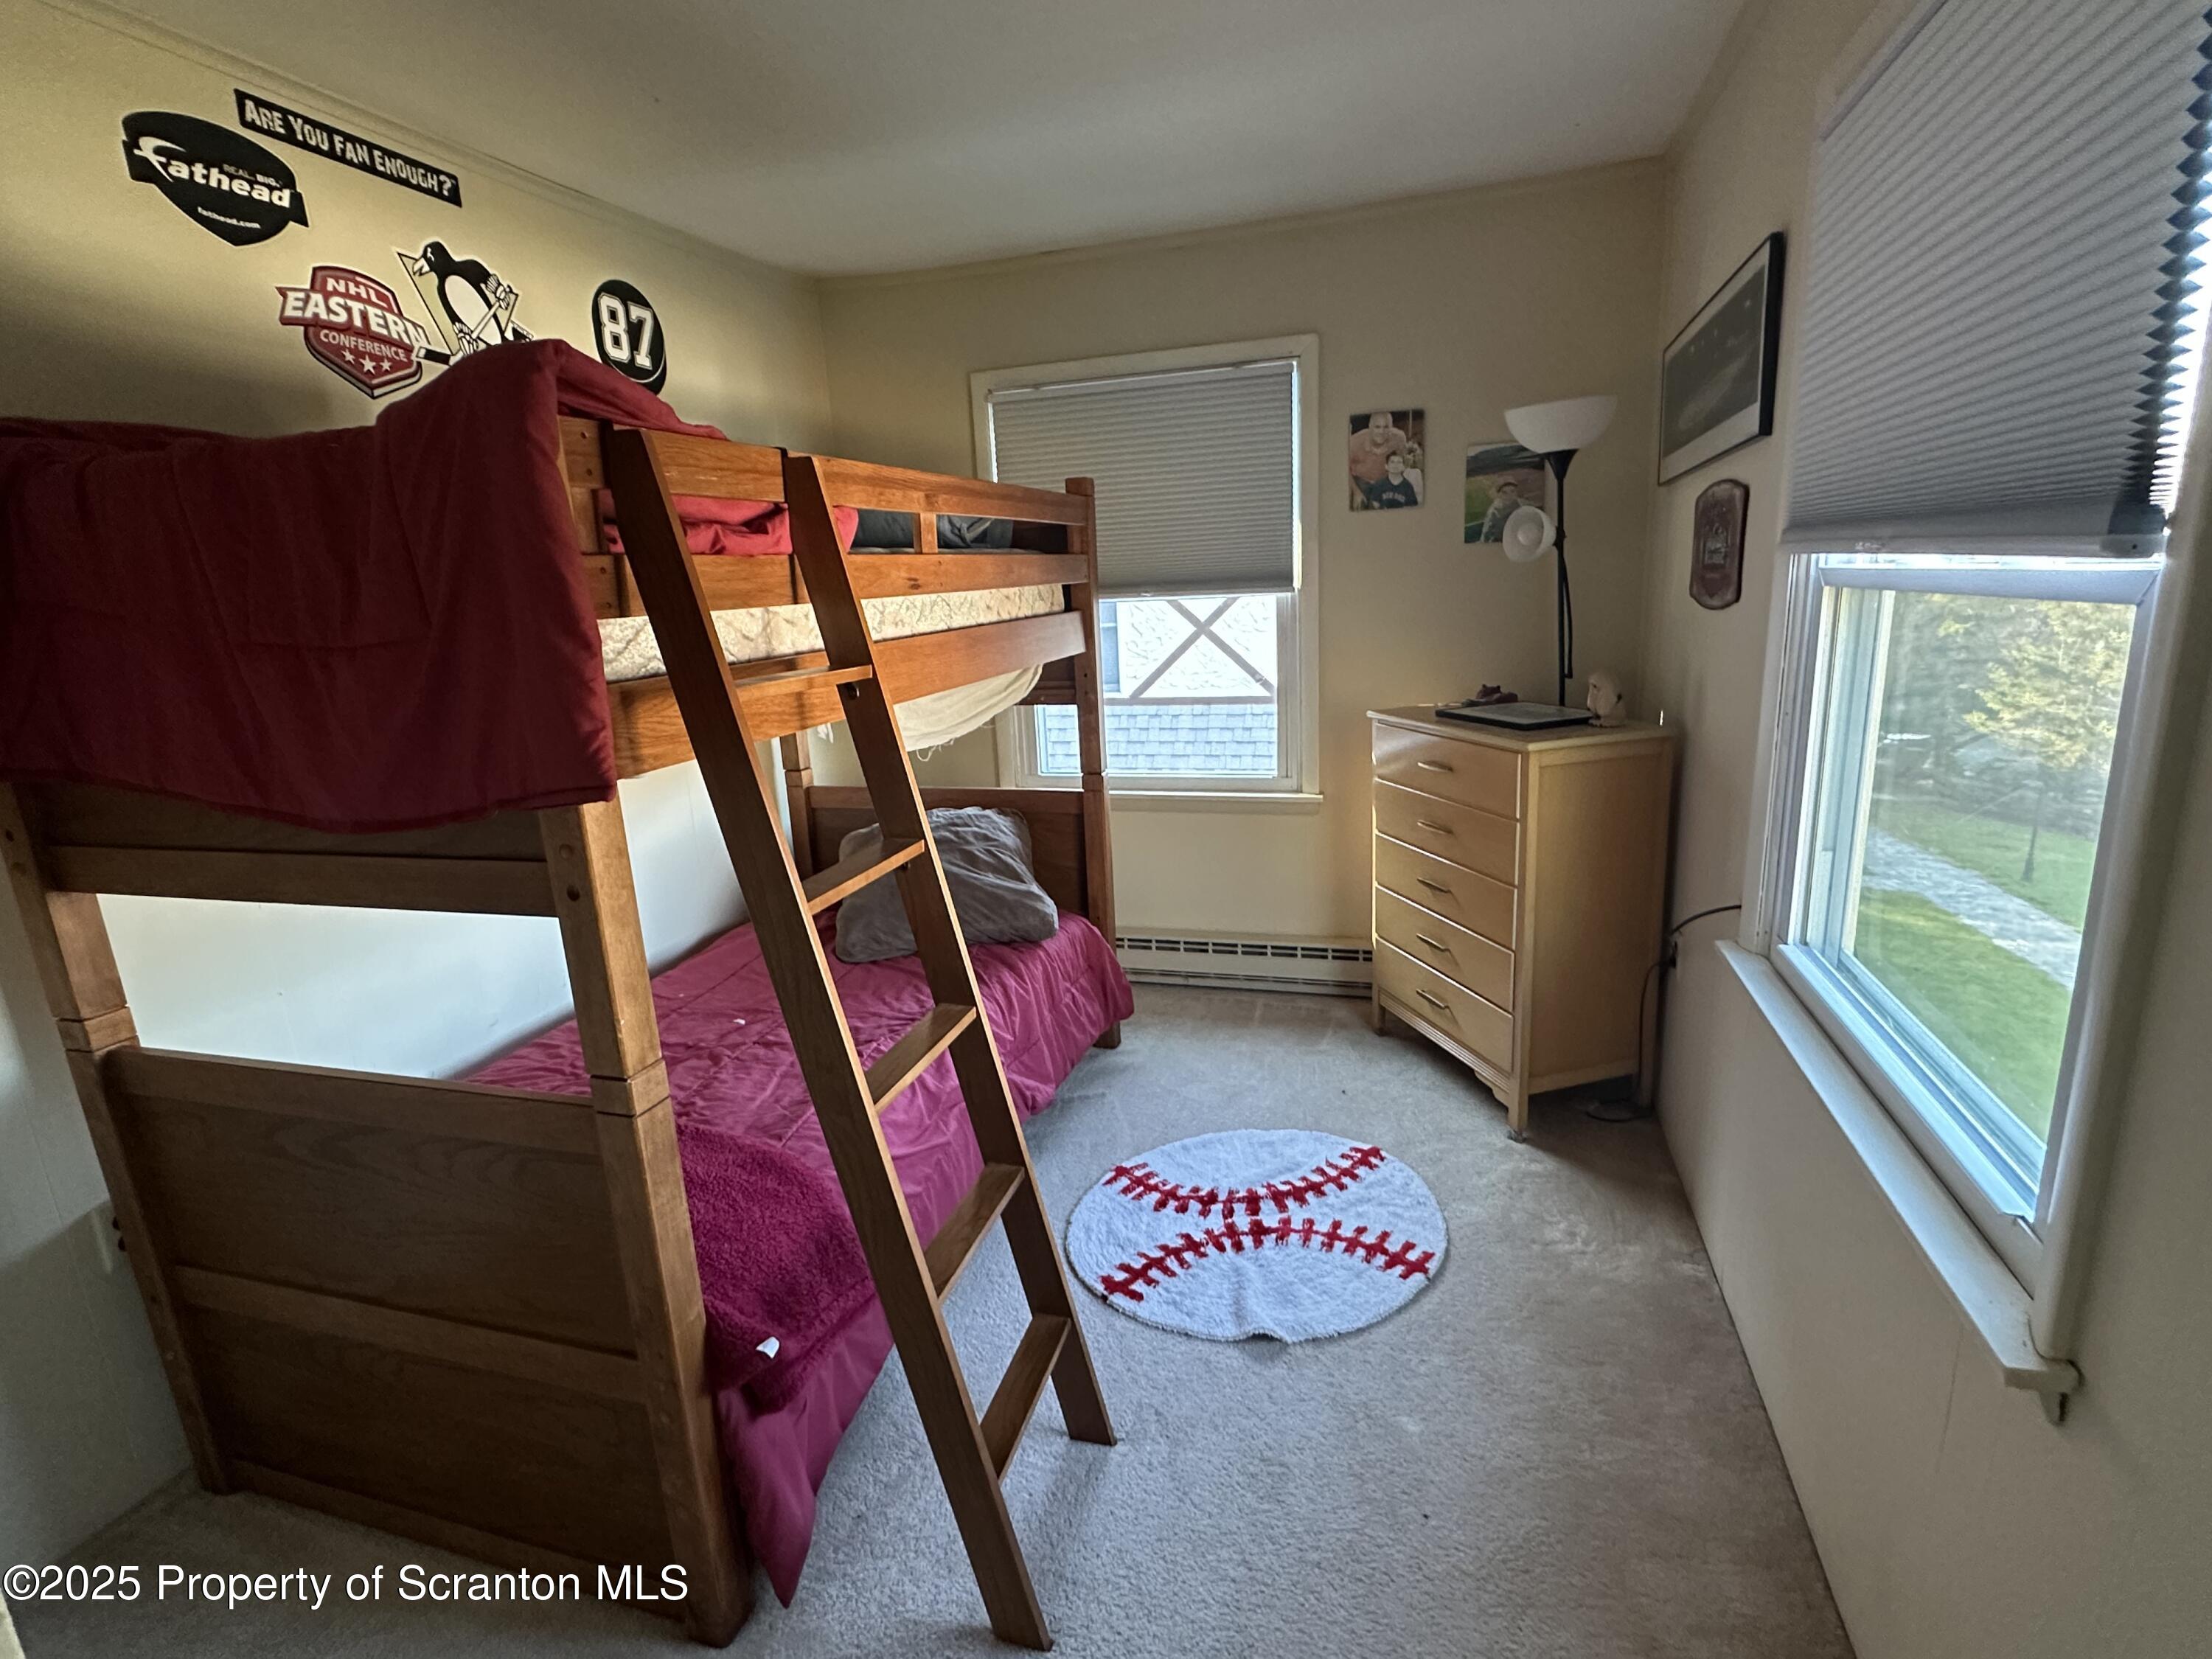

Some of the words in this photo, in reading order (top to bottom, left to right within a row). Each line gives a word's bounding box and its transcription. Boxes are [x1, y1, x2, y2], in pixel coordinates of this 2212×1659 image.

[244, 99, 286, 134] ARE
[288, 115, 329, 151] YOU
[333, 133, 370, 166] FAN
[372, 149, 452, 197] ENOUGH?
[197, 206, 262, 229] fathead.com
[326, 277, 389, 309] NHL
[282, 291, 430, 347] EASTERN
[598, 291, 654, 370] 87
[319, 329, 408, 363] CONFERENCE
